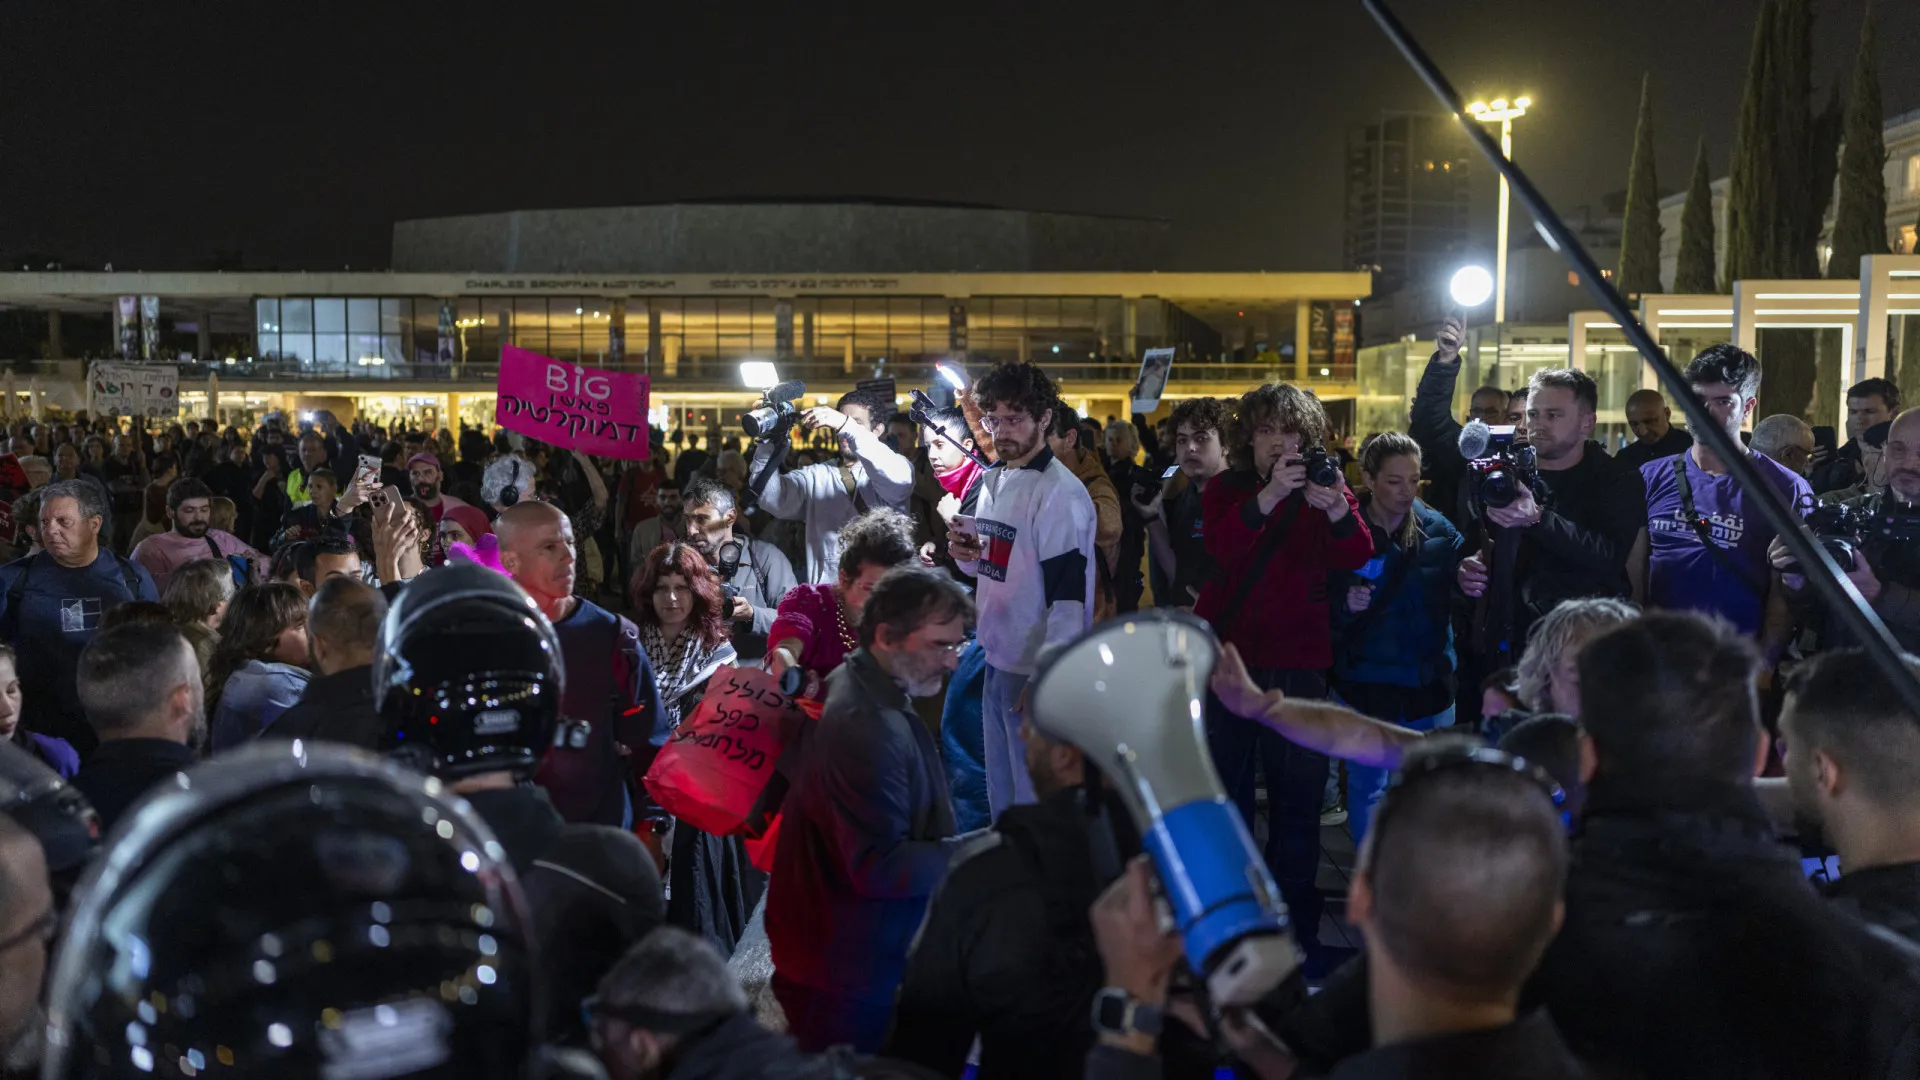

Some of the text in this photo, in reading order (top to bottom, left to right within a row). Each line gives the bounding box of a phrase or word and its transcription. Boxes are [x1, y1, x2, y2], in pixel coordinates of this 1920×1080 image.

[465, 279, 676, 290] CHARLES BRONFMAN AUDITORIUM
[501, 395, 640, 442] דמוקרטיה
[1652, 519, 1687, 533] ביחד
[709, 702, 760, 732] כפל
